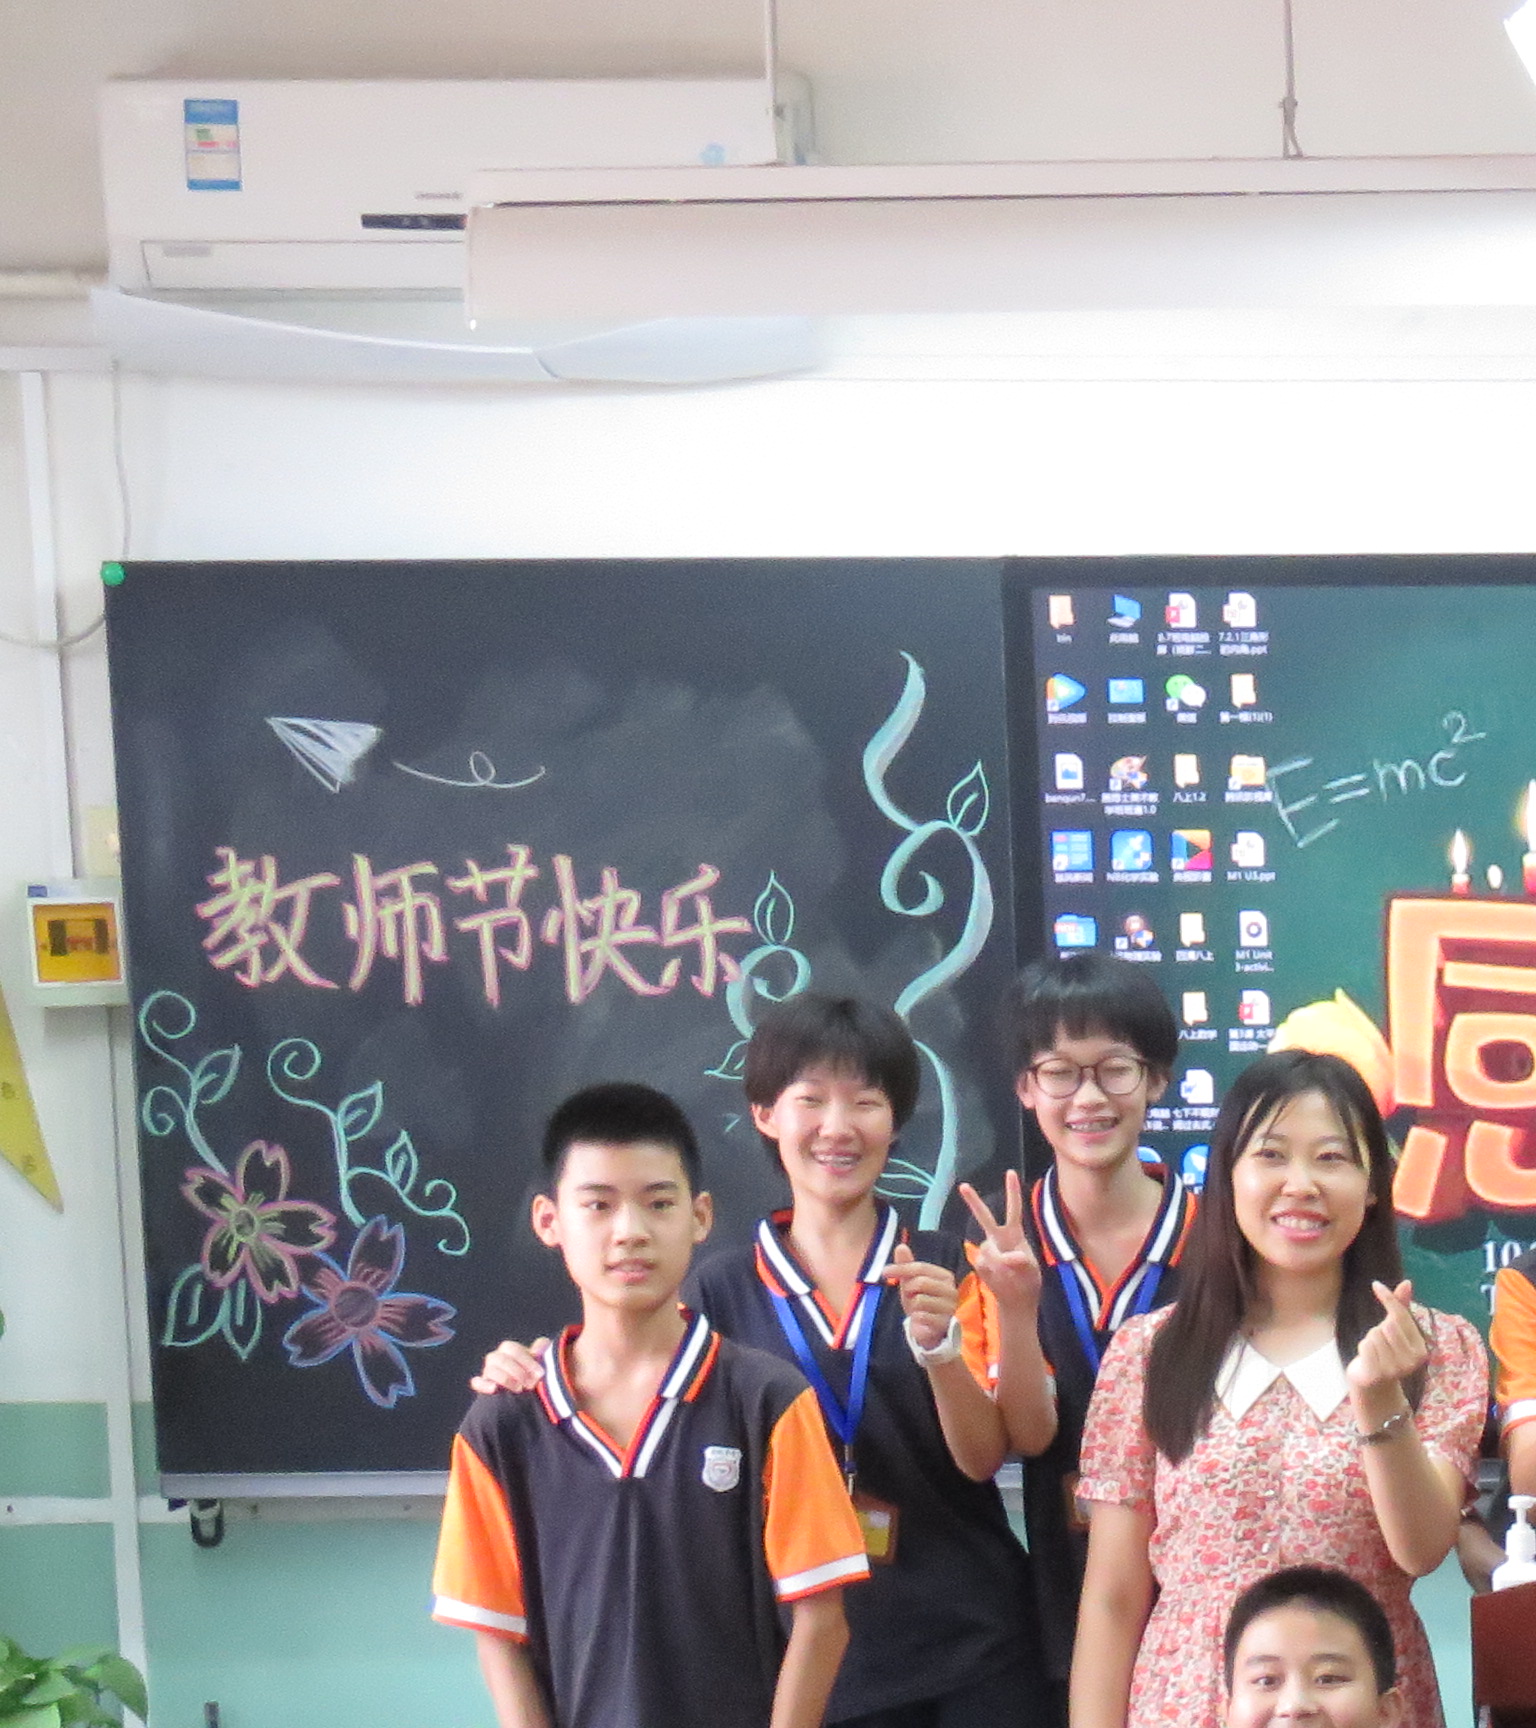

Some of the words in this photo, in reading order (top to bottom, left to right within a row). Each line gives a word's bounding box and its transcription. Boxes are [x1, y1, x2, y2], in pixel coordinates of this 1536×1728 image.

[198, 844, 752, 1008] 教师节快乐
